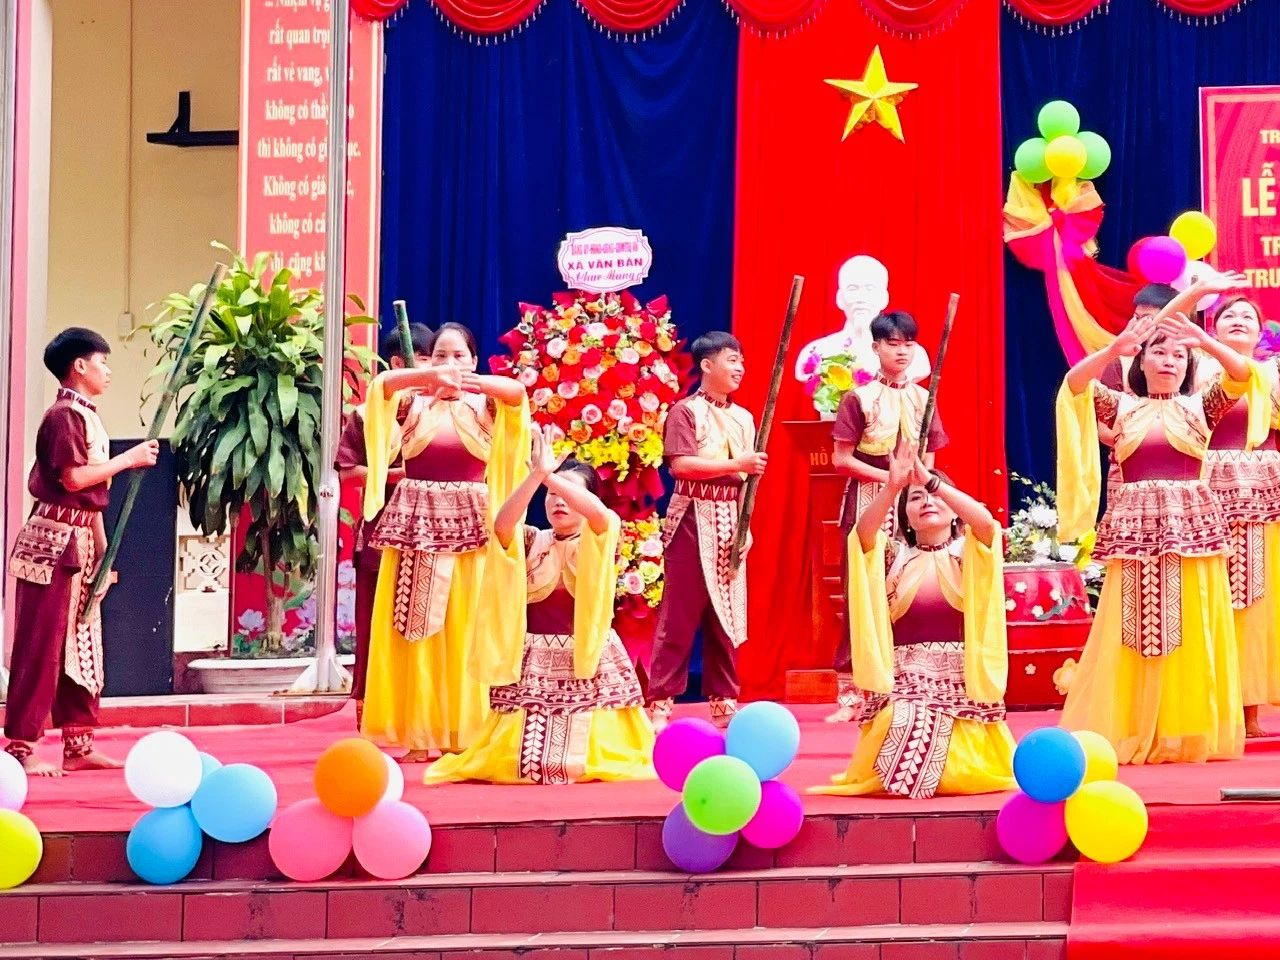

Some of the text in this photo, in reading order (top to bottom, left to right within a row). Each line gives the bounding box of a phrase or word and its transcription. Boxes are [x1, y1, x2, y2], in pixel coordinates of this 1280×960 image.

[269, 17, 311, 51] rất quan
[267, 55, 282, 82] rất
[297, 66, 323, 88] vang,
[265, 98, 309, 126] không có
[273, 136, 304, 164] không
[305, 136, 317, 158] có
[263, 174, 310, 202] Không có
[1242, 162, 1277, 217] LỄ
[269, 212, 313, 240] không có
